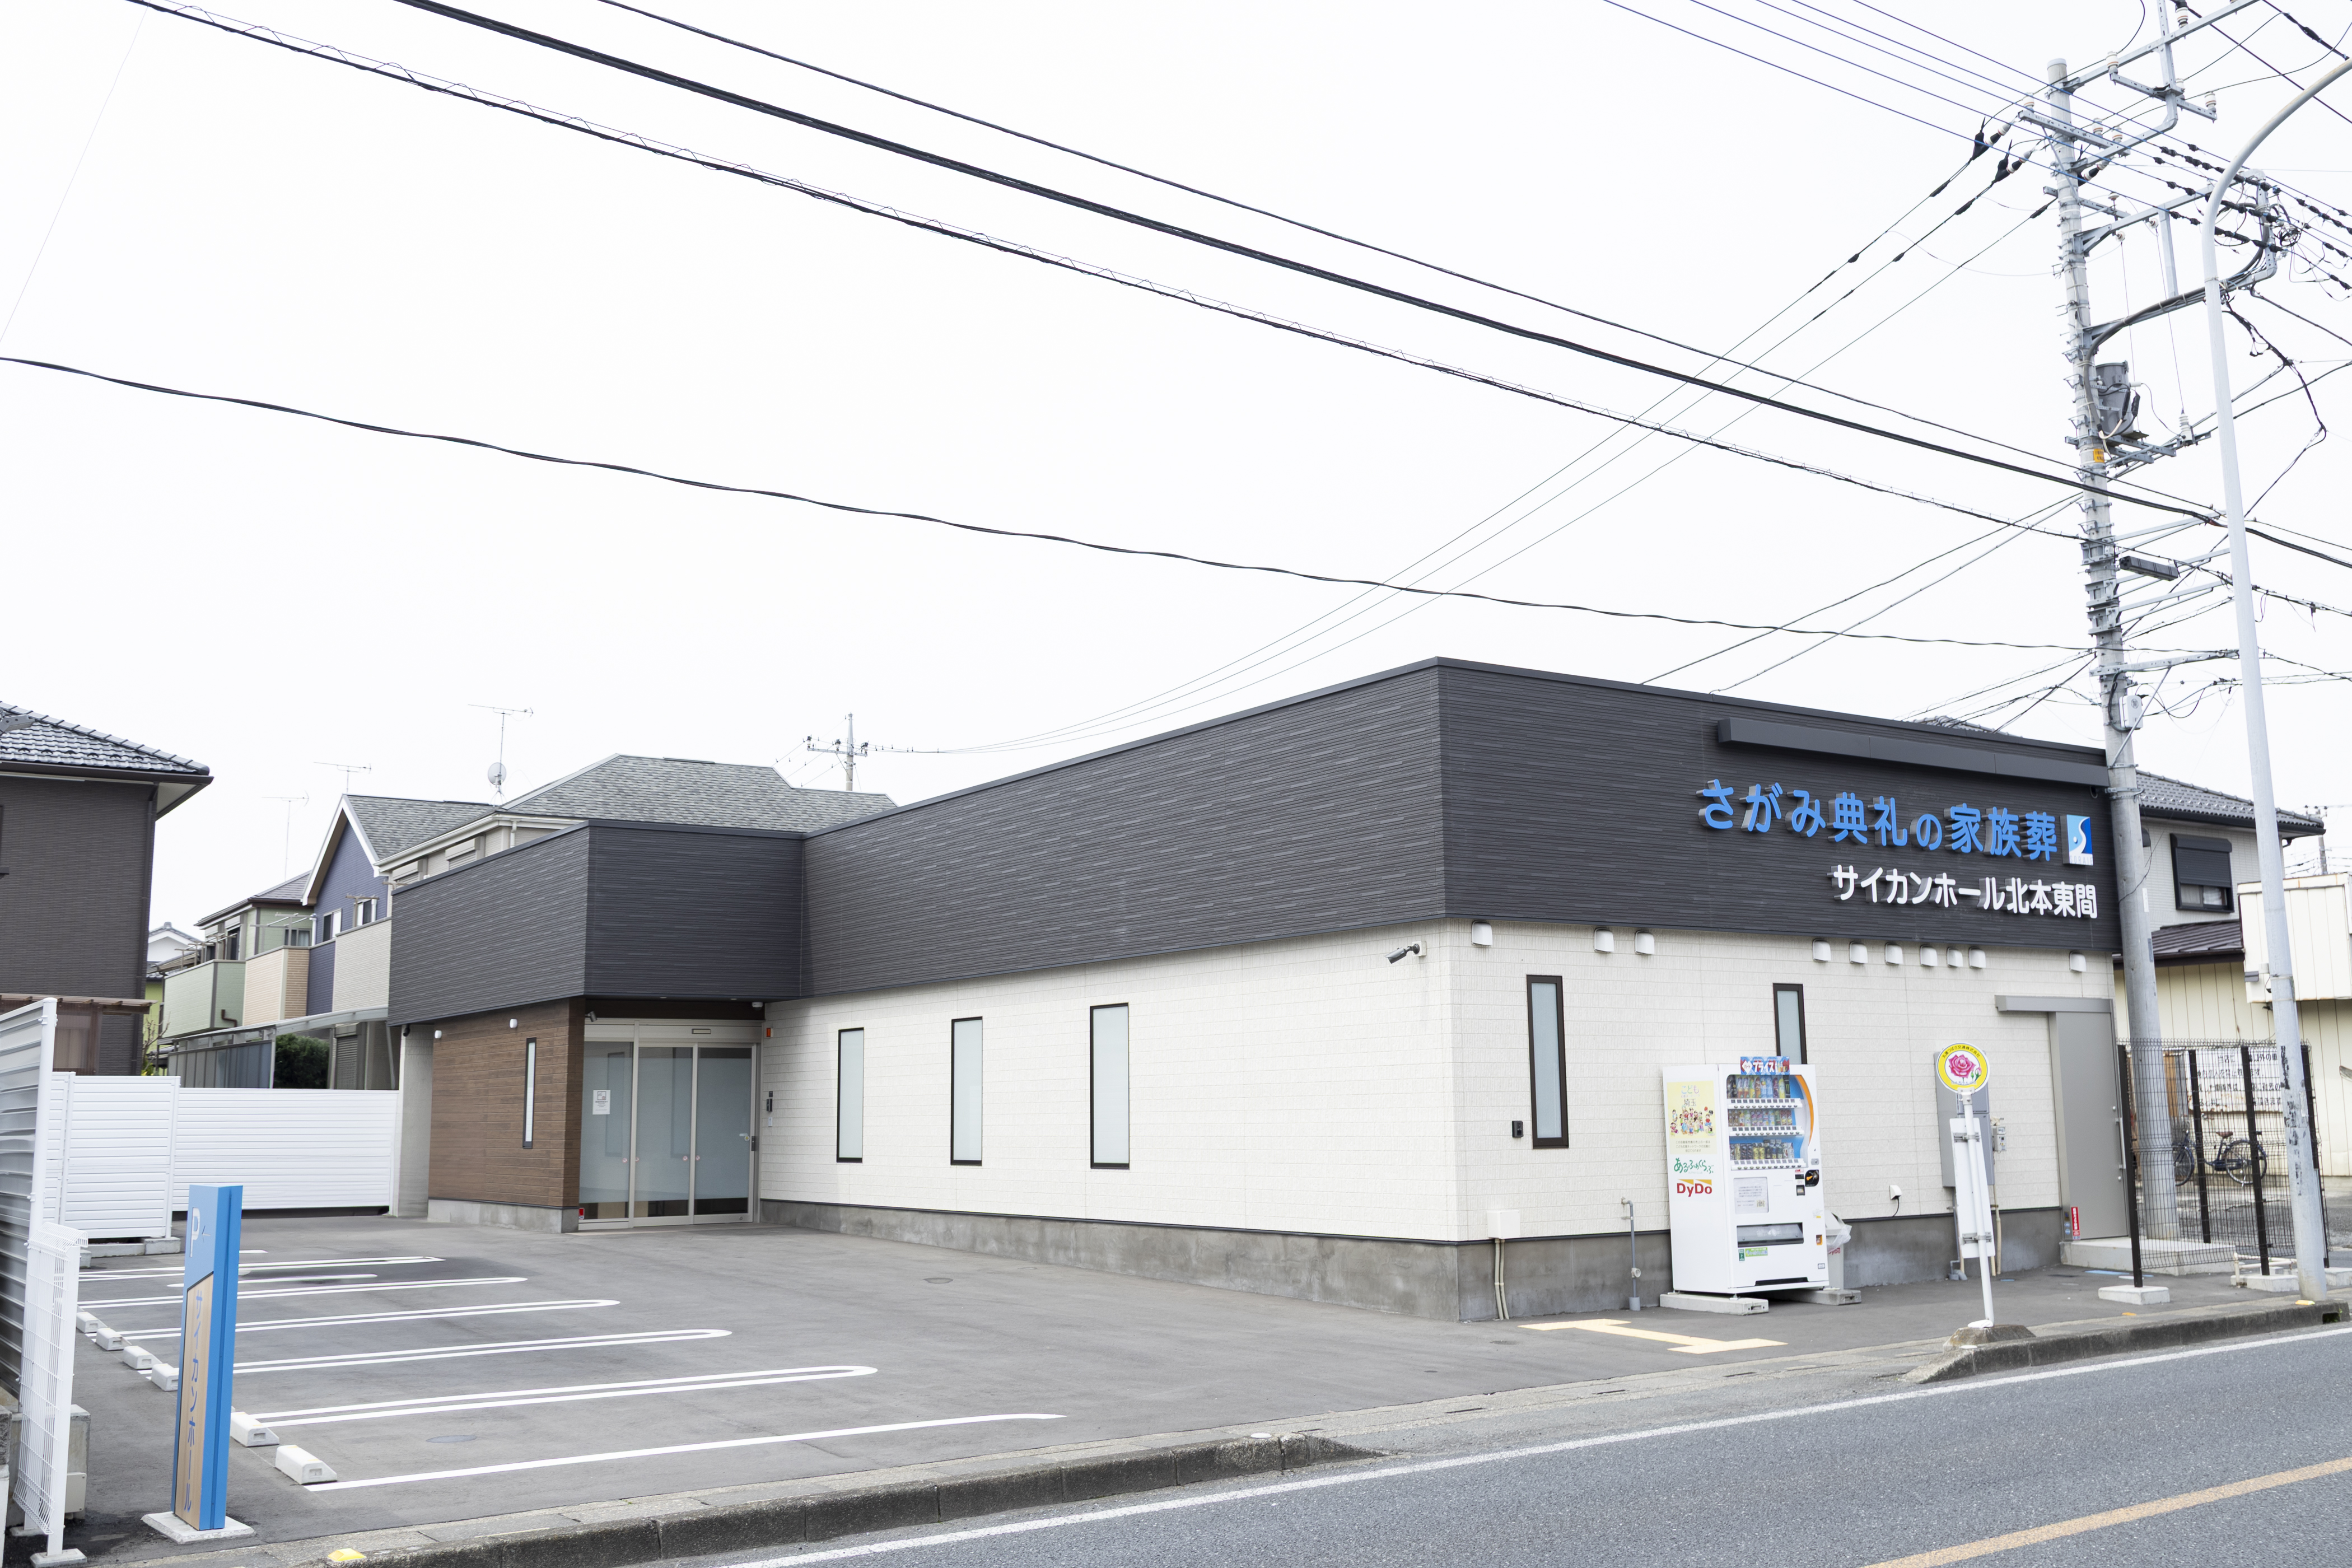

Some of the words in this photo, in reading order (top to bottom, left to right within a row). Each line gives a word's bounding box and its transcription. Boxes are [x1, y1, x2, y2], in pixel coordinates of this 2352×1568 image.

[1701, 778, 2057, 861] さがみ典礼の家族葬
[1832, 864, 2098, 918] サイカンホール北本東間
[1681, 1085, 1700, 1094] こども
[1684, 1098, 1697, 1107] 埼玉
[1677, 1183, 1712, 1197] DyDo
[189, 1207, 200, 1258] P
[1828, 1247, 1841, 1256] yDo
[183, 1290, 203, 1511] サイカンホール
